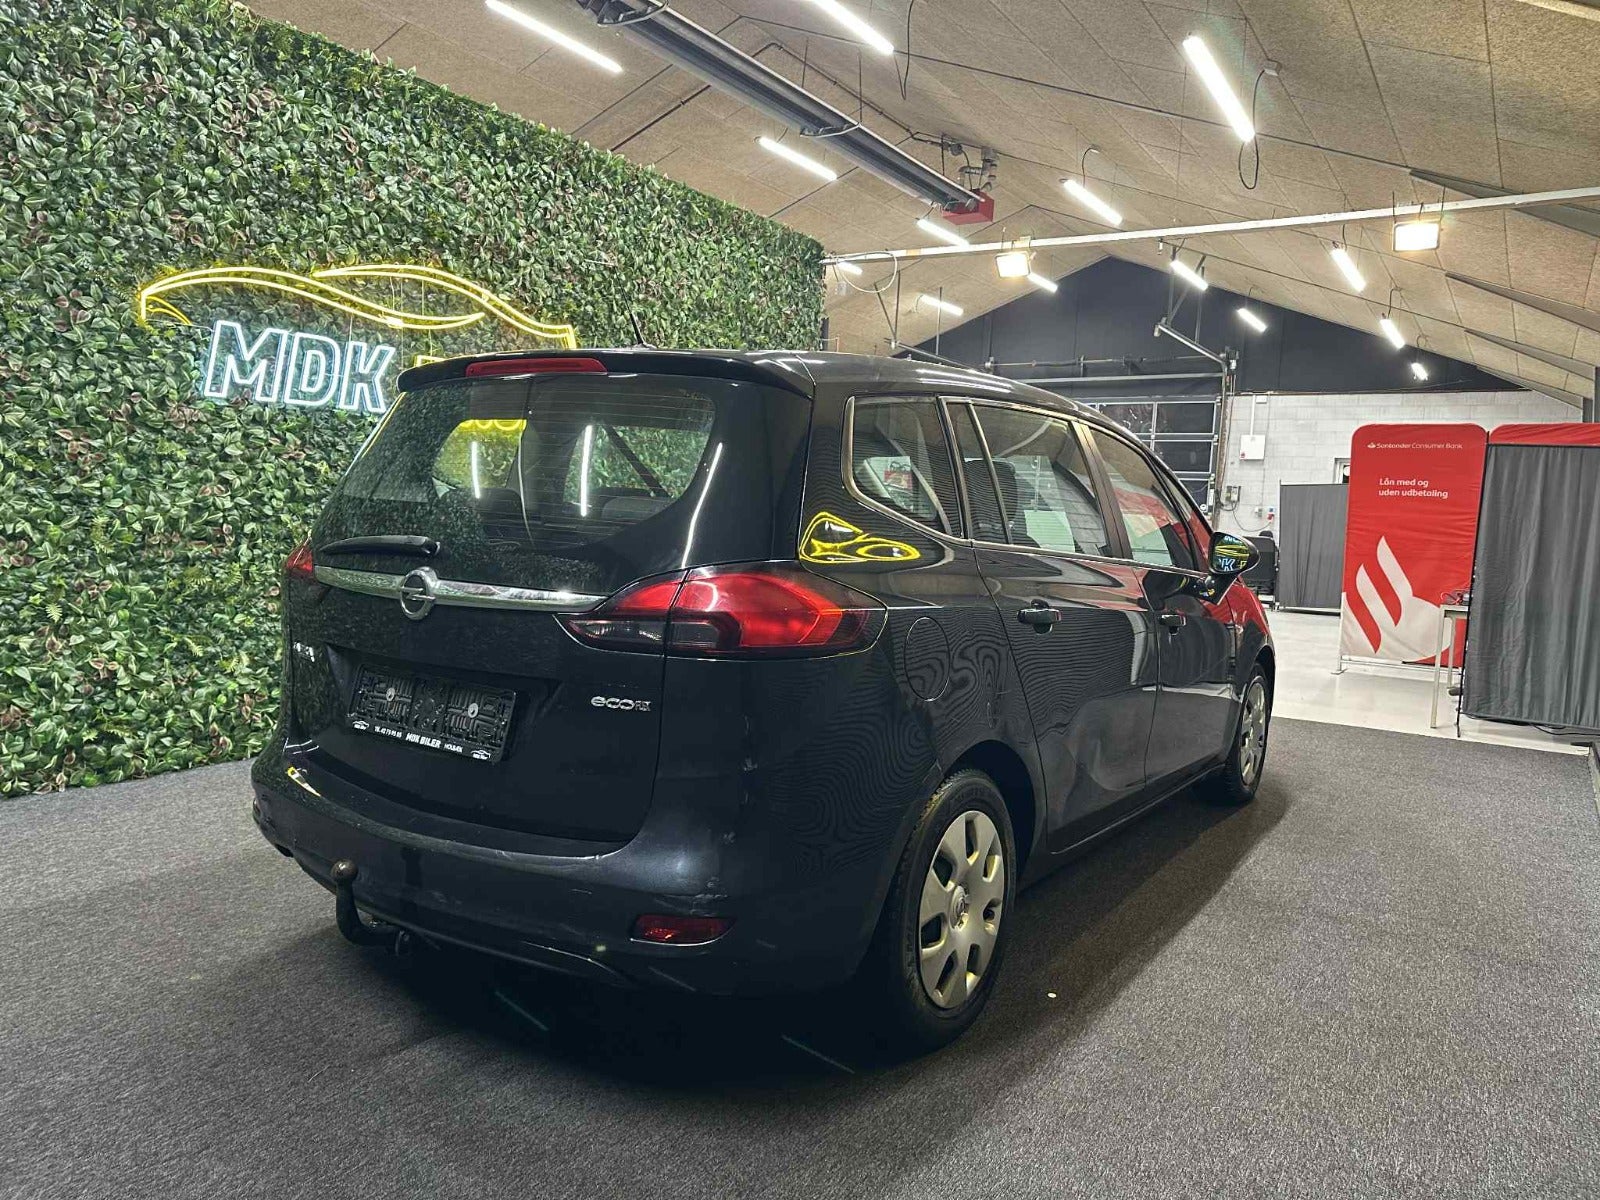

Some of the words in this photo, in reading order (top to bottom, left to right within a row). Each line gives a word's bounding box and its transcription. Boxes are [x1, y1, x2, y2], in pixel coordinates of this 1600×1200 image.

[203, 319, 396, 414] MDK
[1379, 477, 1395, 486] Lån
[1396, 478, 1416, 486] med
[1417, 480, 1429, 488] og
[1401, 489, 1449, 499] udbetaling
